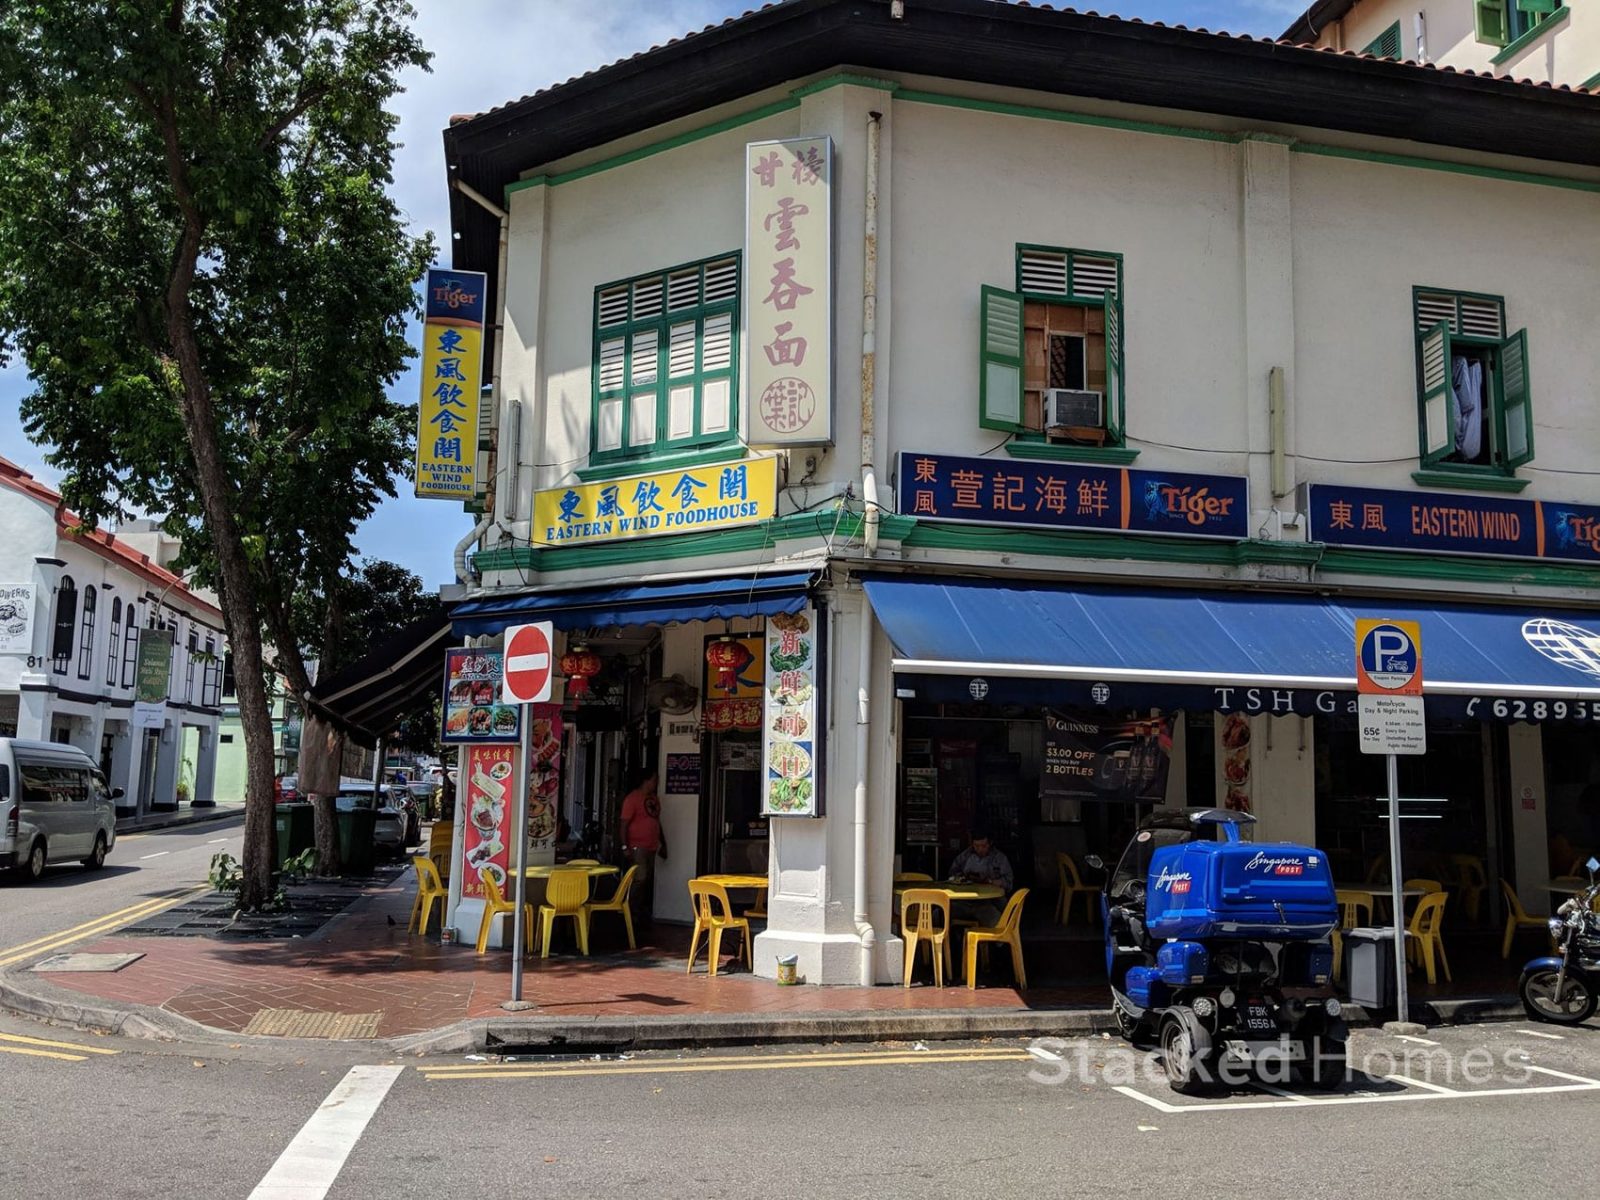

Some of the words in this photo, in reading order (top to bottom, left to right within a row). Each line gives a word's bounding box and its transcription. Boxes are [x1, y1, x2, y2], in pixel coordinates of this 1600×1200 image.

[762, 196, 814, 368] 雲吞面
[433, 286, 477, 309] Tiger
[421, 462, 473, 474] EASTERN
[421, 481, 472, 492] FOODHOUSE
[431, 472, 462, 483] WIND
[913, 457, 938, 515] 東風
[950, 468, 1110, 517] 萱記海鮮
[1161, 485, 1234, 526] Tiger
[546, 519, 613, 541] EASTERN
[618, 513, 660, 532] WIND
[665, 501, 759, 527] FOODHOUSE
[1329, 499, 1388, 533] 東風
[1410, 504, 1479, 540] EASTERN
[1482, 509, 1521, 542] WIND
[1374, 630, 1409, 672] P
[27, 655, 43, 669] 81
[1214, 687, 1295, 713] TSH
[1384, 707, 1397, 715] Night
[1399, 708, 1419, 716] Parking
[1056, 720, 1099, 734] GUINNESS
[1363, 726, 1380, 736] 65¢
[1046, 747, 1073, 758] $3.00
[1074, 750, 1097, 761] OFF
[1045, 764, 1052, 774] 2
[1053, 765, 1095, 776] BOTTLES
[1244, 850, 1304, 874] Singapore
[1175, 883, 1188, 891] POST
[1248, 1005, 1268, 1017] FBK
